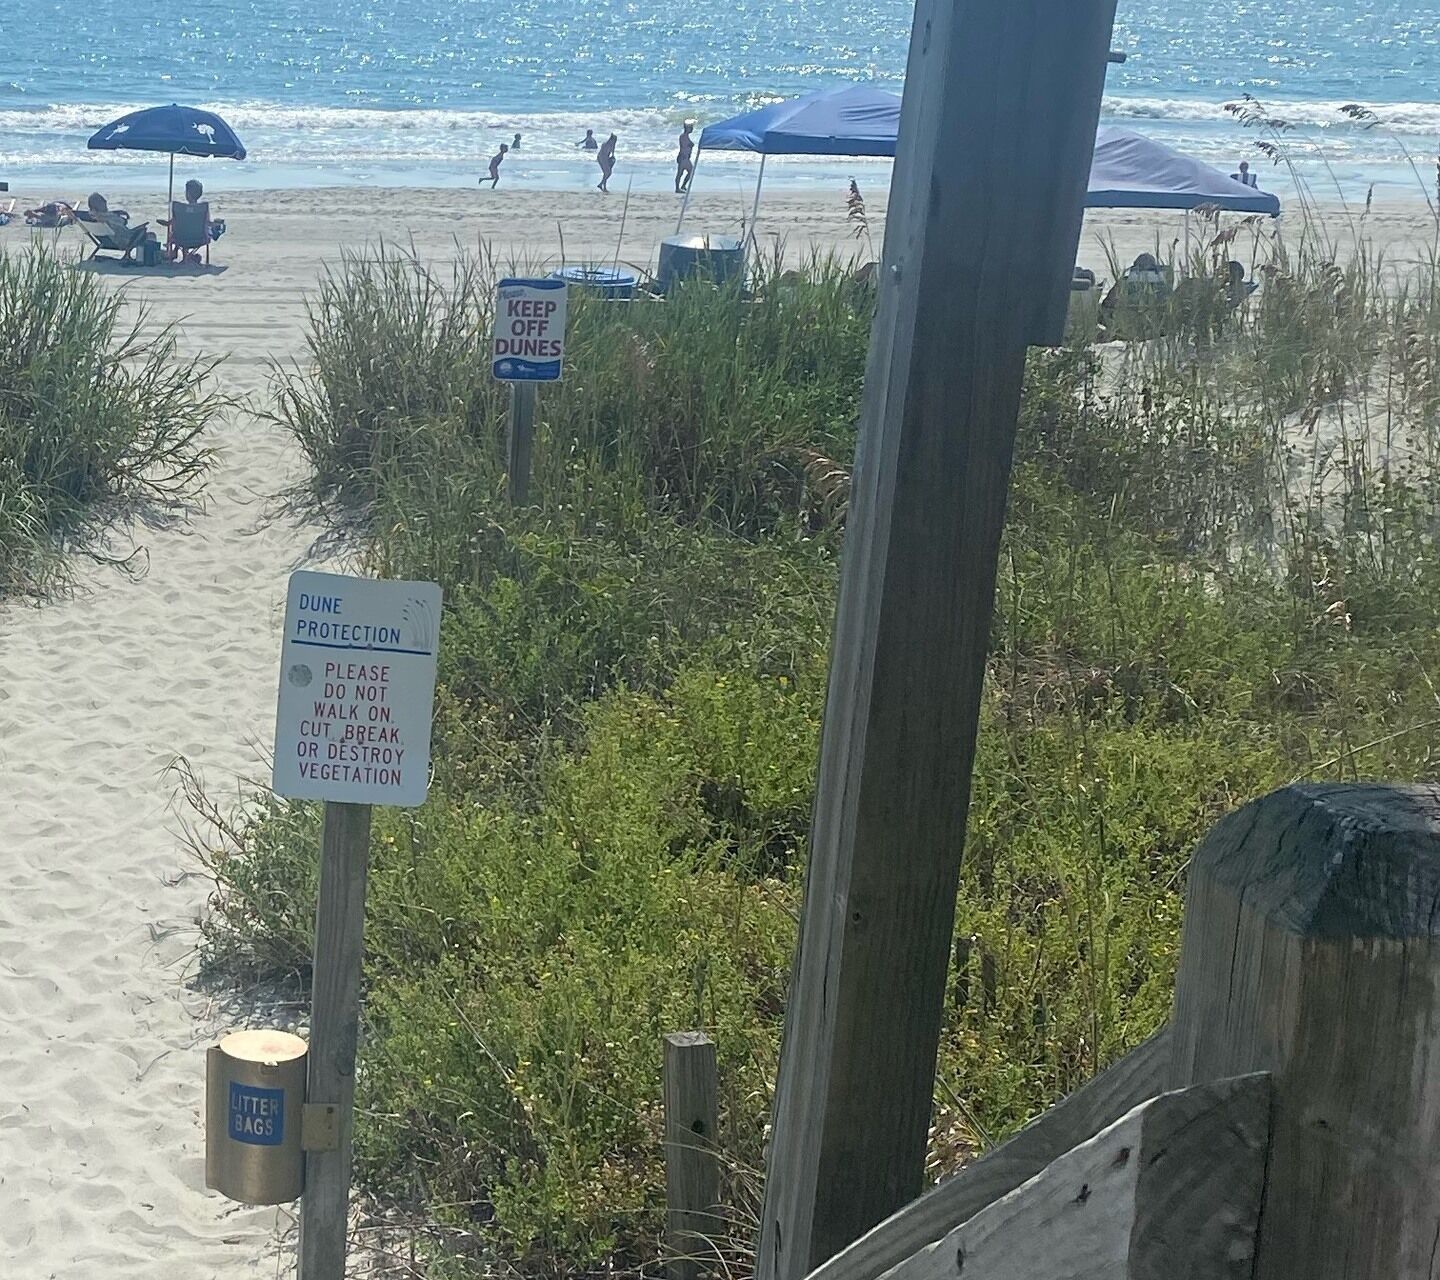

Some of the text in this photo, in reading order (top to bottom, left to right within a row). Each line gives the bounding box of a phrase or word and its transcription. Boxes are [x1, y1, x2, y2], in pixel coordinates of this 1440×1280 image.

[507, 300, 557, 318] KEEP
[511, 319, 549, 337] OFF
[495, 339, 561, 357] DUNES
[299, 593, 343, 614] DUNE
[297, 619, 401, 644] PROTECTION
[325, 662, 390, 683] PLEASE
[324, 683, 388, 702] DO NOT
[314, 701, 359, 721] WALK
[297, 741, 405, 766] OR DESTROY
[299, 761, 401, 786] VEGETATION
[231, 1093, 279, 1116] LITTER
[235, 1115, 273, 1136] BAGS
